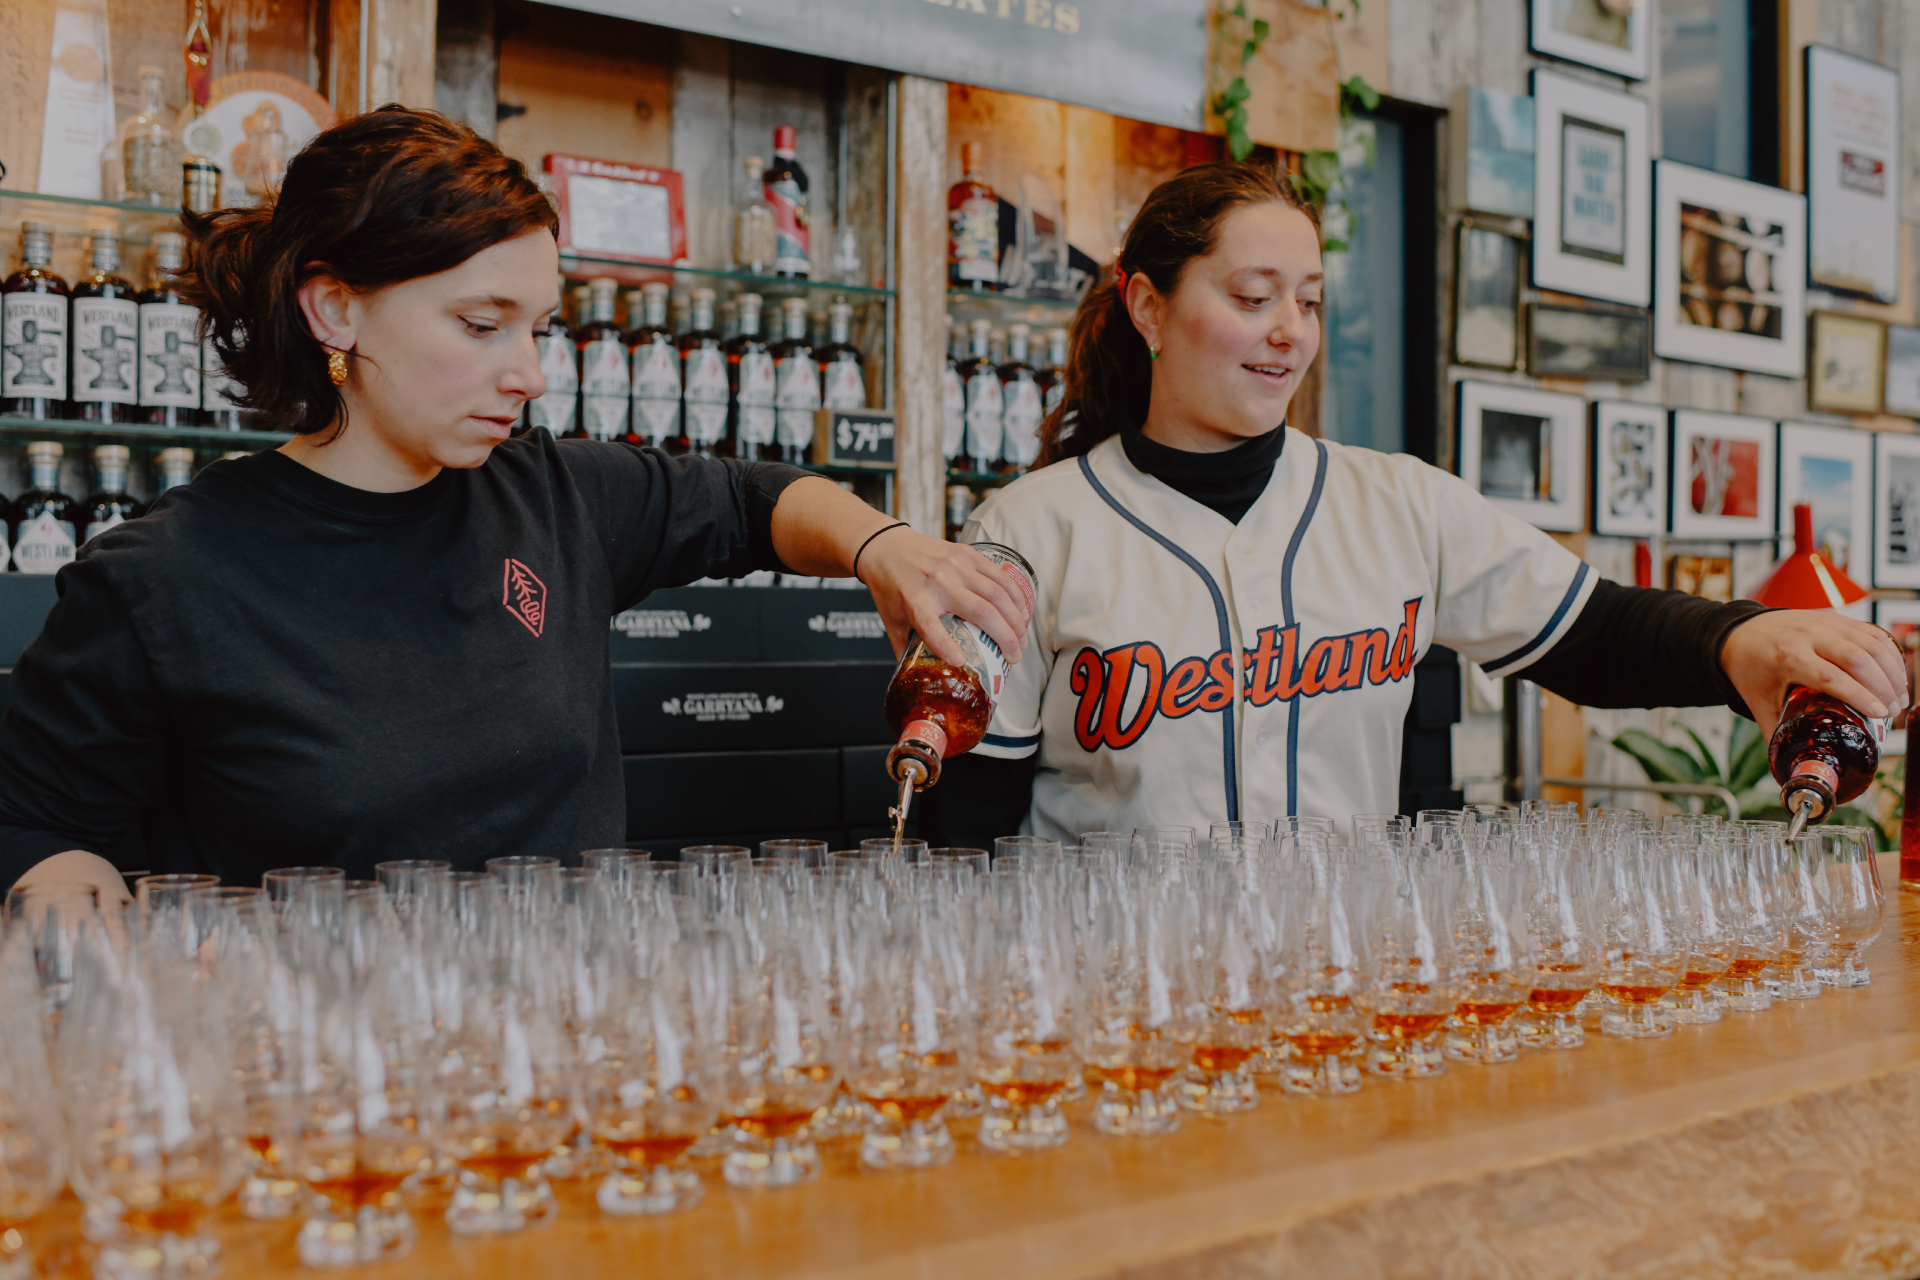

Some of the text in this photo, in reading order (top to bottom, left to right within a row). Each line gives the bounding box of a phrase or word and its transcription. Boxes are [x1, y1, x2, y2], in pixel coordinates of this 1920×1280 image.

[6, 303, 60, 322] WESTLAND
[1070, 596, 1423, 752] Westland
[684, 699, 763, 714] GARRYANA
